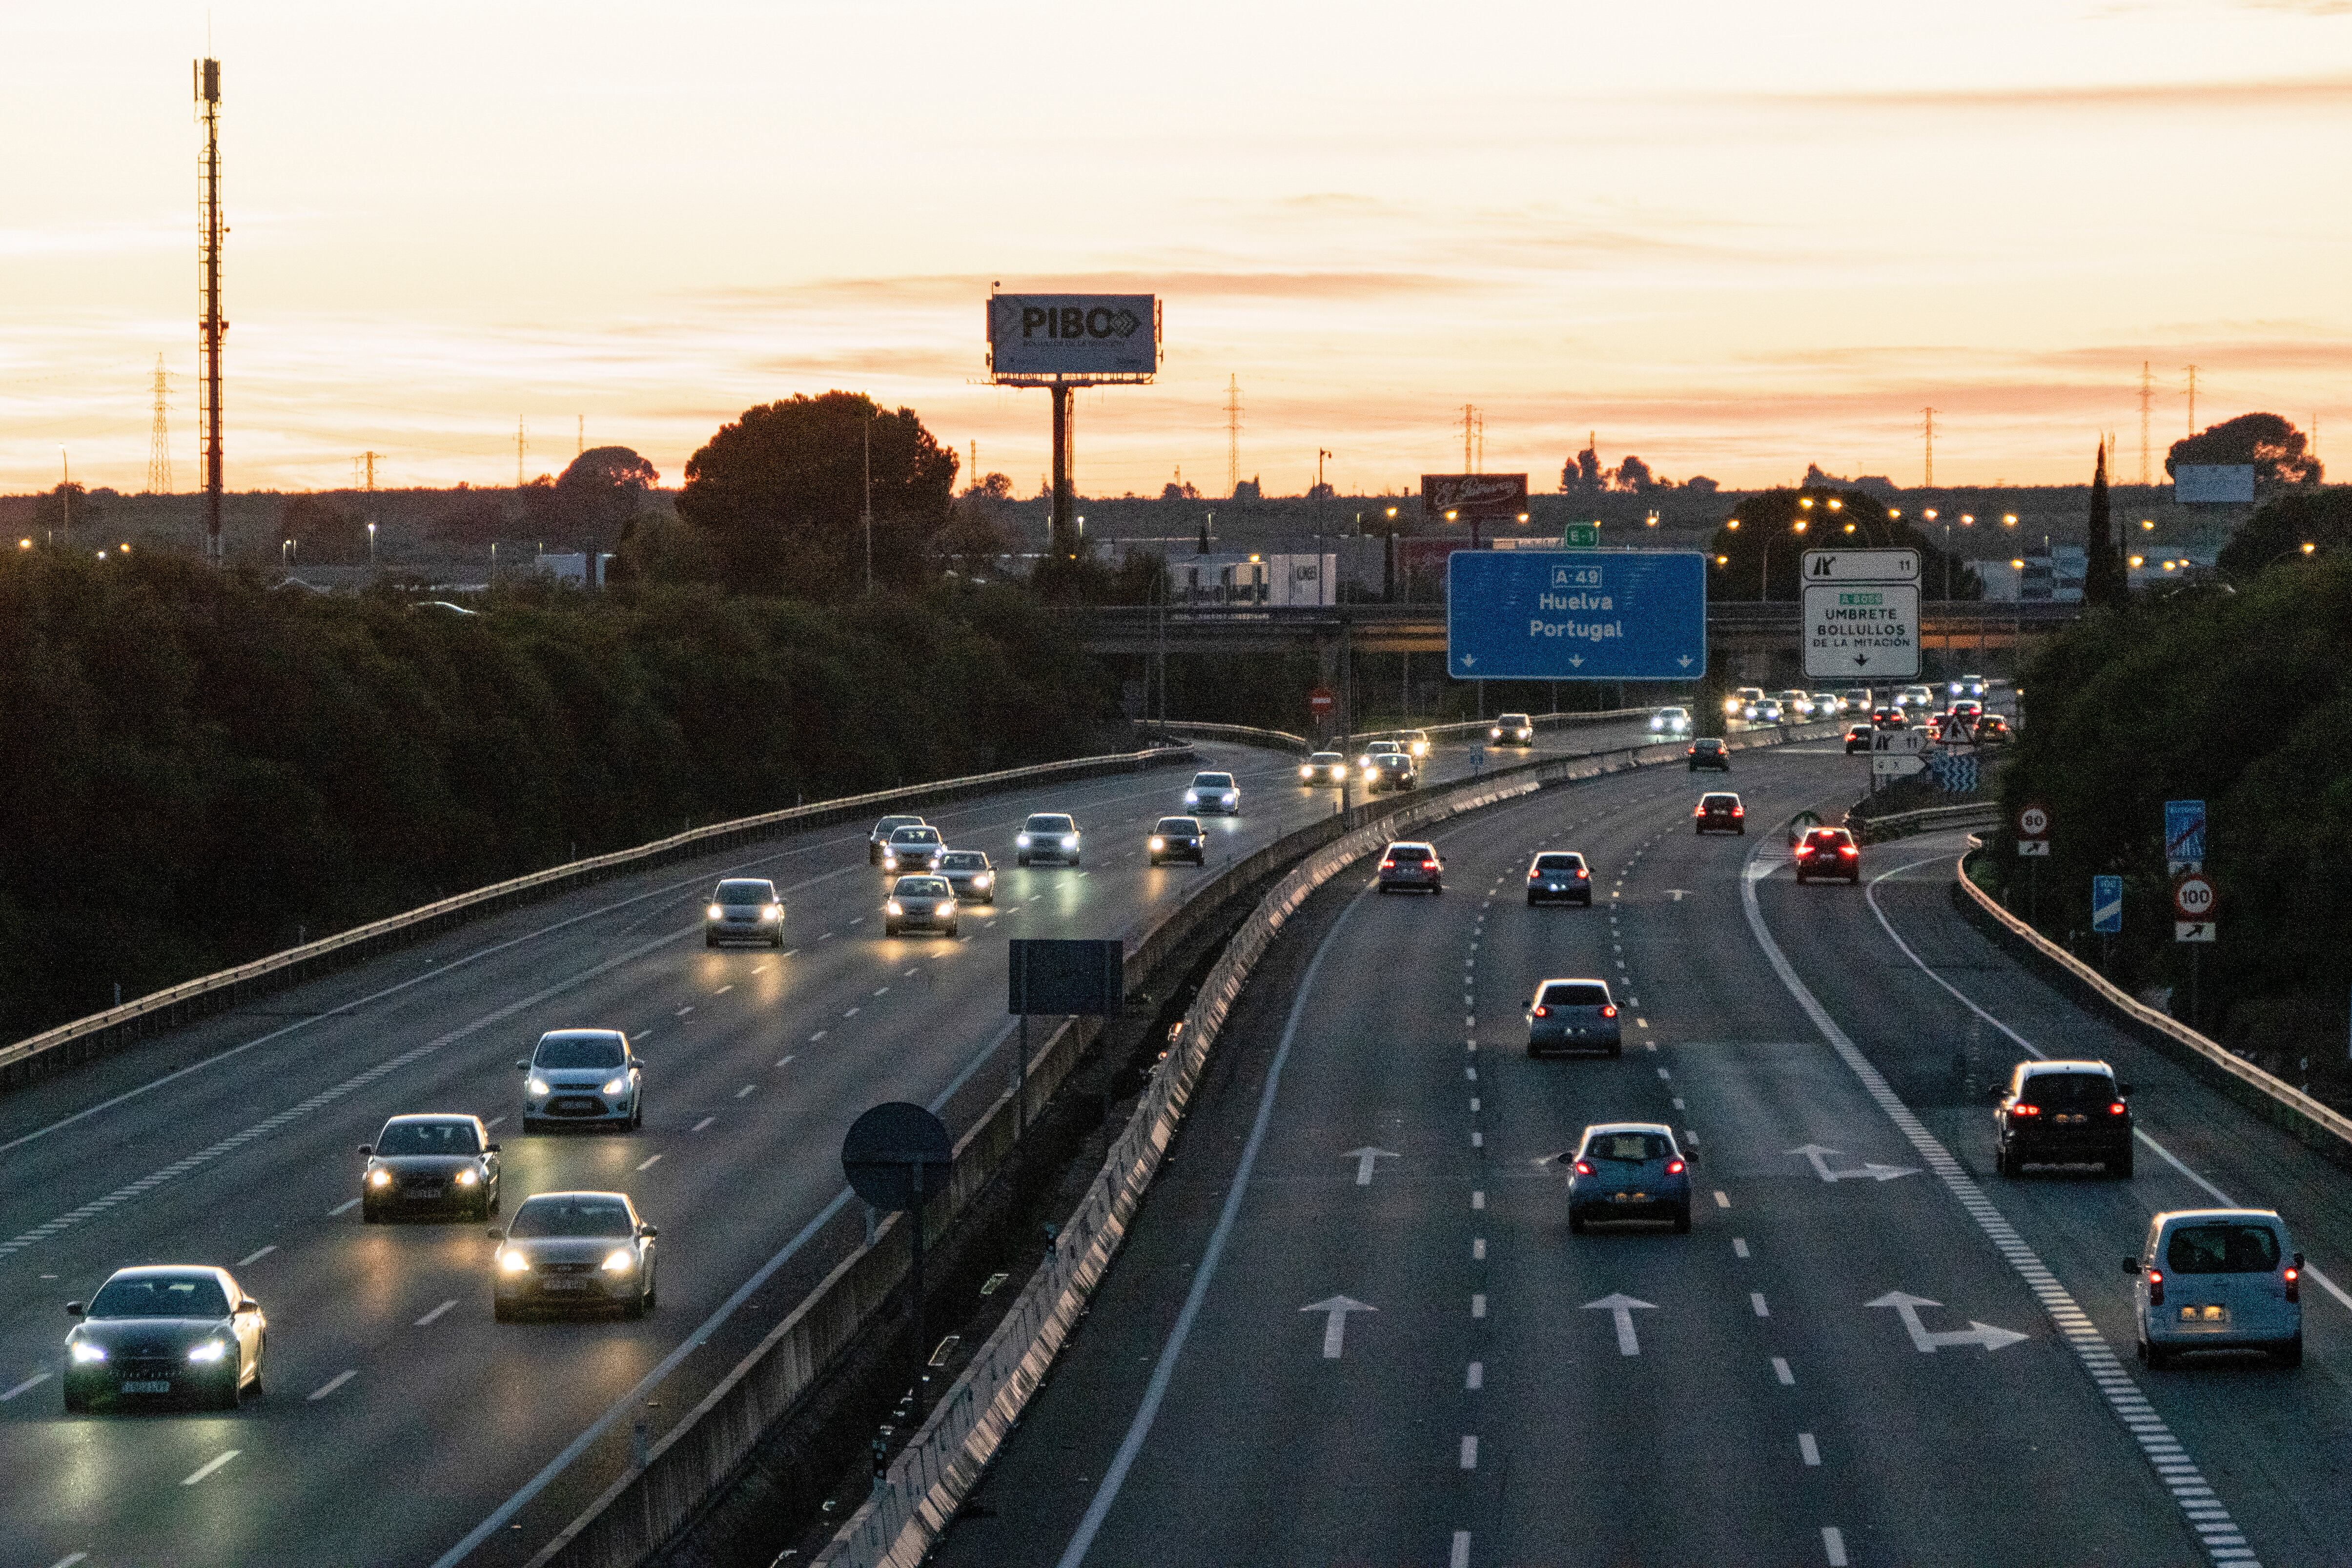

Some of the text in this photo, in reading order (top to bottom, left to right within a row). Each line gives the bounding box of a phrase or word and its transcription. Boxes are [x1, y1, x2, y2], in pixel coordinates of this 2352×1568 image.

[1023, 307, 1114, 339] PIBO
[1900, 560, 1910, 571] 11
[1539, 593, 1613, 610] Huelva
[1825, 609, 1896, 620] UMBRETE
[1530, 620, 1623, 642] Portugal
[1818, 625, 1905, 636] BOLLULLOS
[1813, 637, 1910, 647] DE LA MITACIÓN
[1906, 737, 1917, 748] 11
[2025, 815, 2044, 826] 80
[2183, 890, 2209, 904] 100
